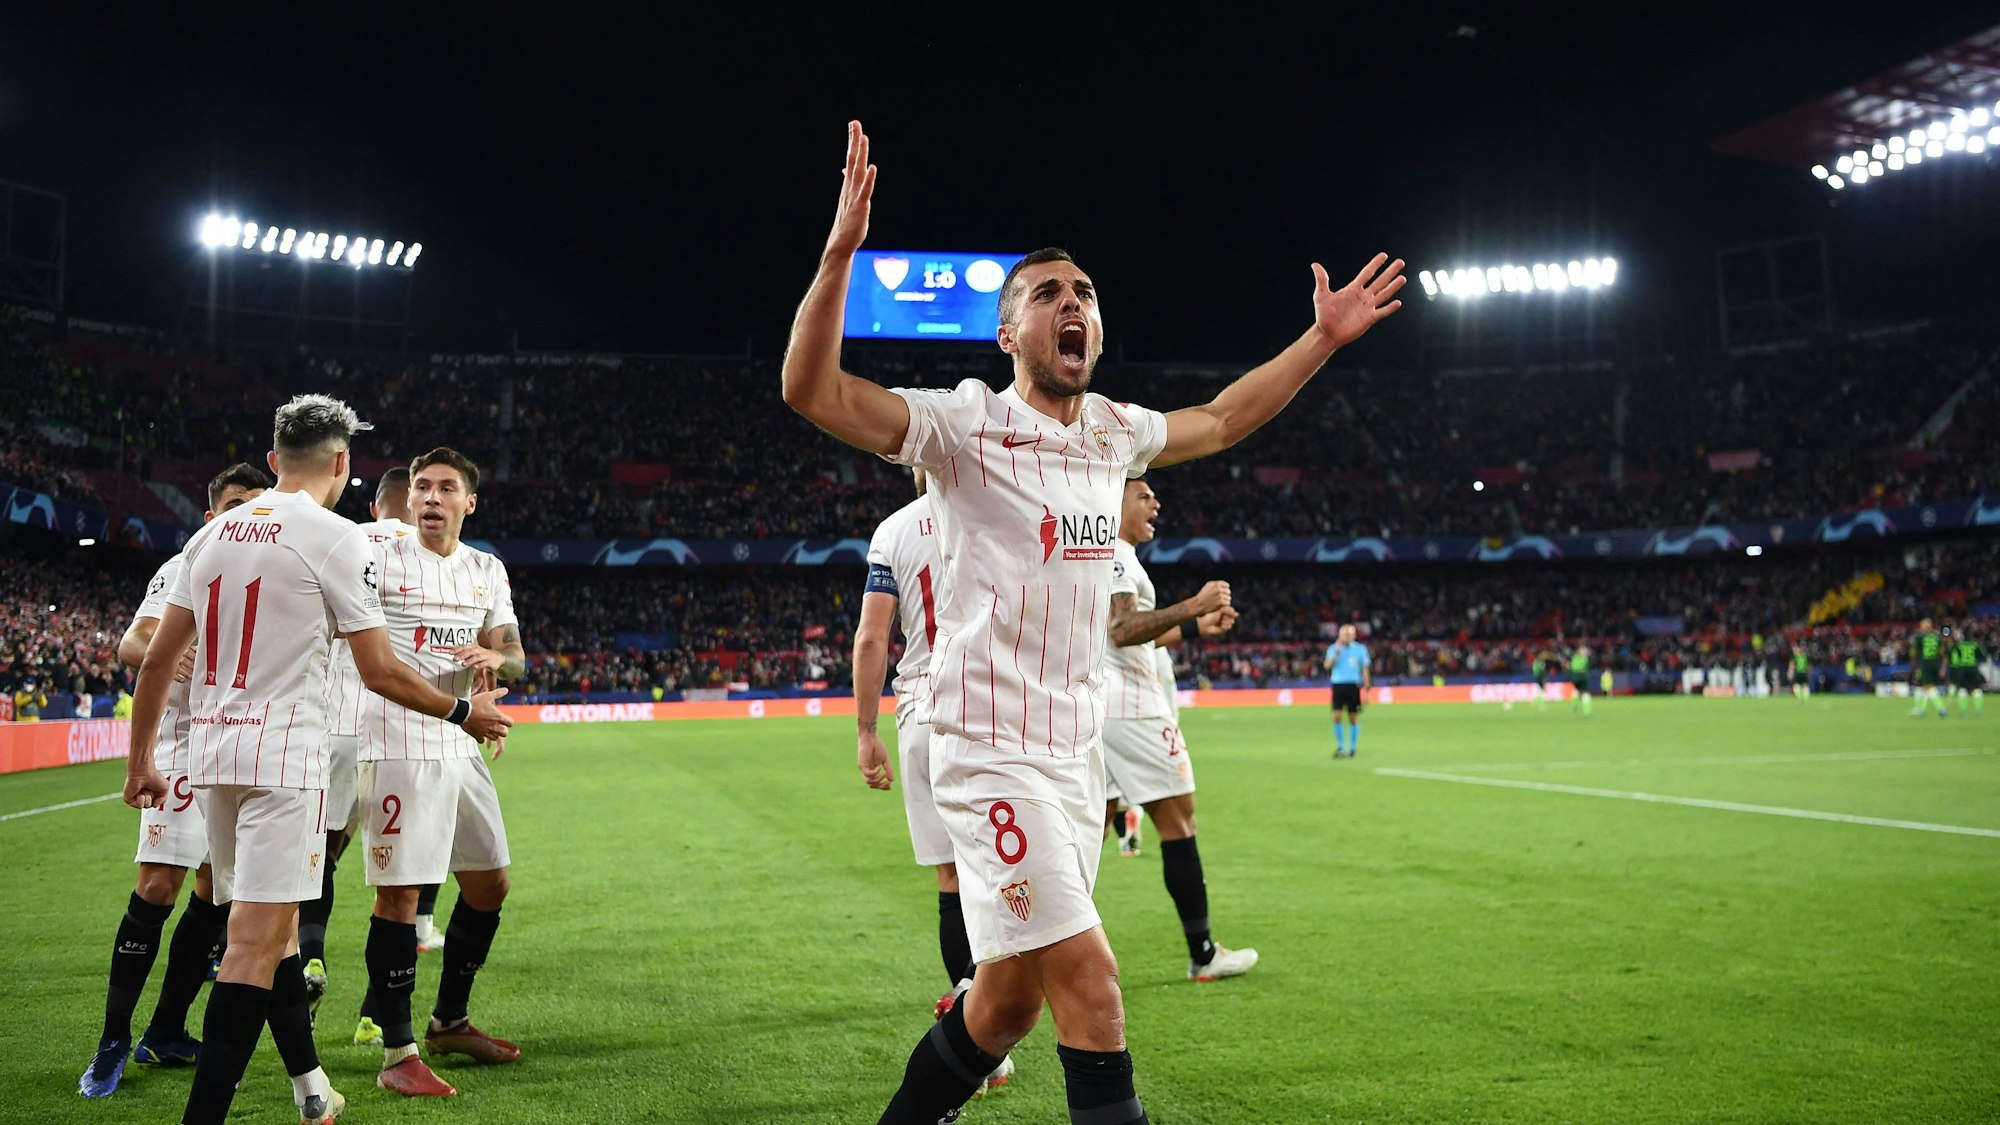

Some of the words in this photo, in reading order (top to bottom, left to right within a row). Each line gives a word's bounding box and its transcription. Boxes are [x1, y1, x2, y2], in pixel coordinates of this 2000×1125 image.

[218, 521, 283, 545] MUNIR
[1062, 514, 1116, 546] NAGA
[204, 573, 262, 690] 11
[430, 626, 473, 646] NAGA
[224, 715, 261, 726] Unidas
[540, 703, 654, 723] GATORADE
[68, 720, 132, 765] GATORAD
[381, 794, 402, 835] 2
[988, 800, 1028, 865] 8
